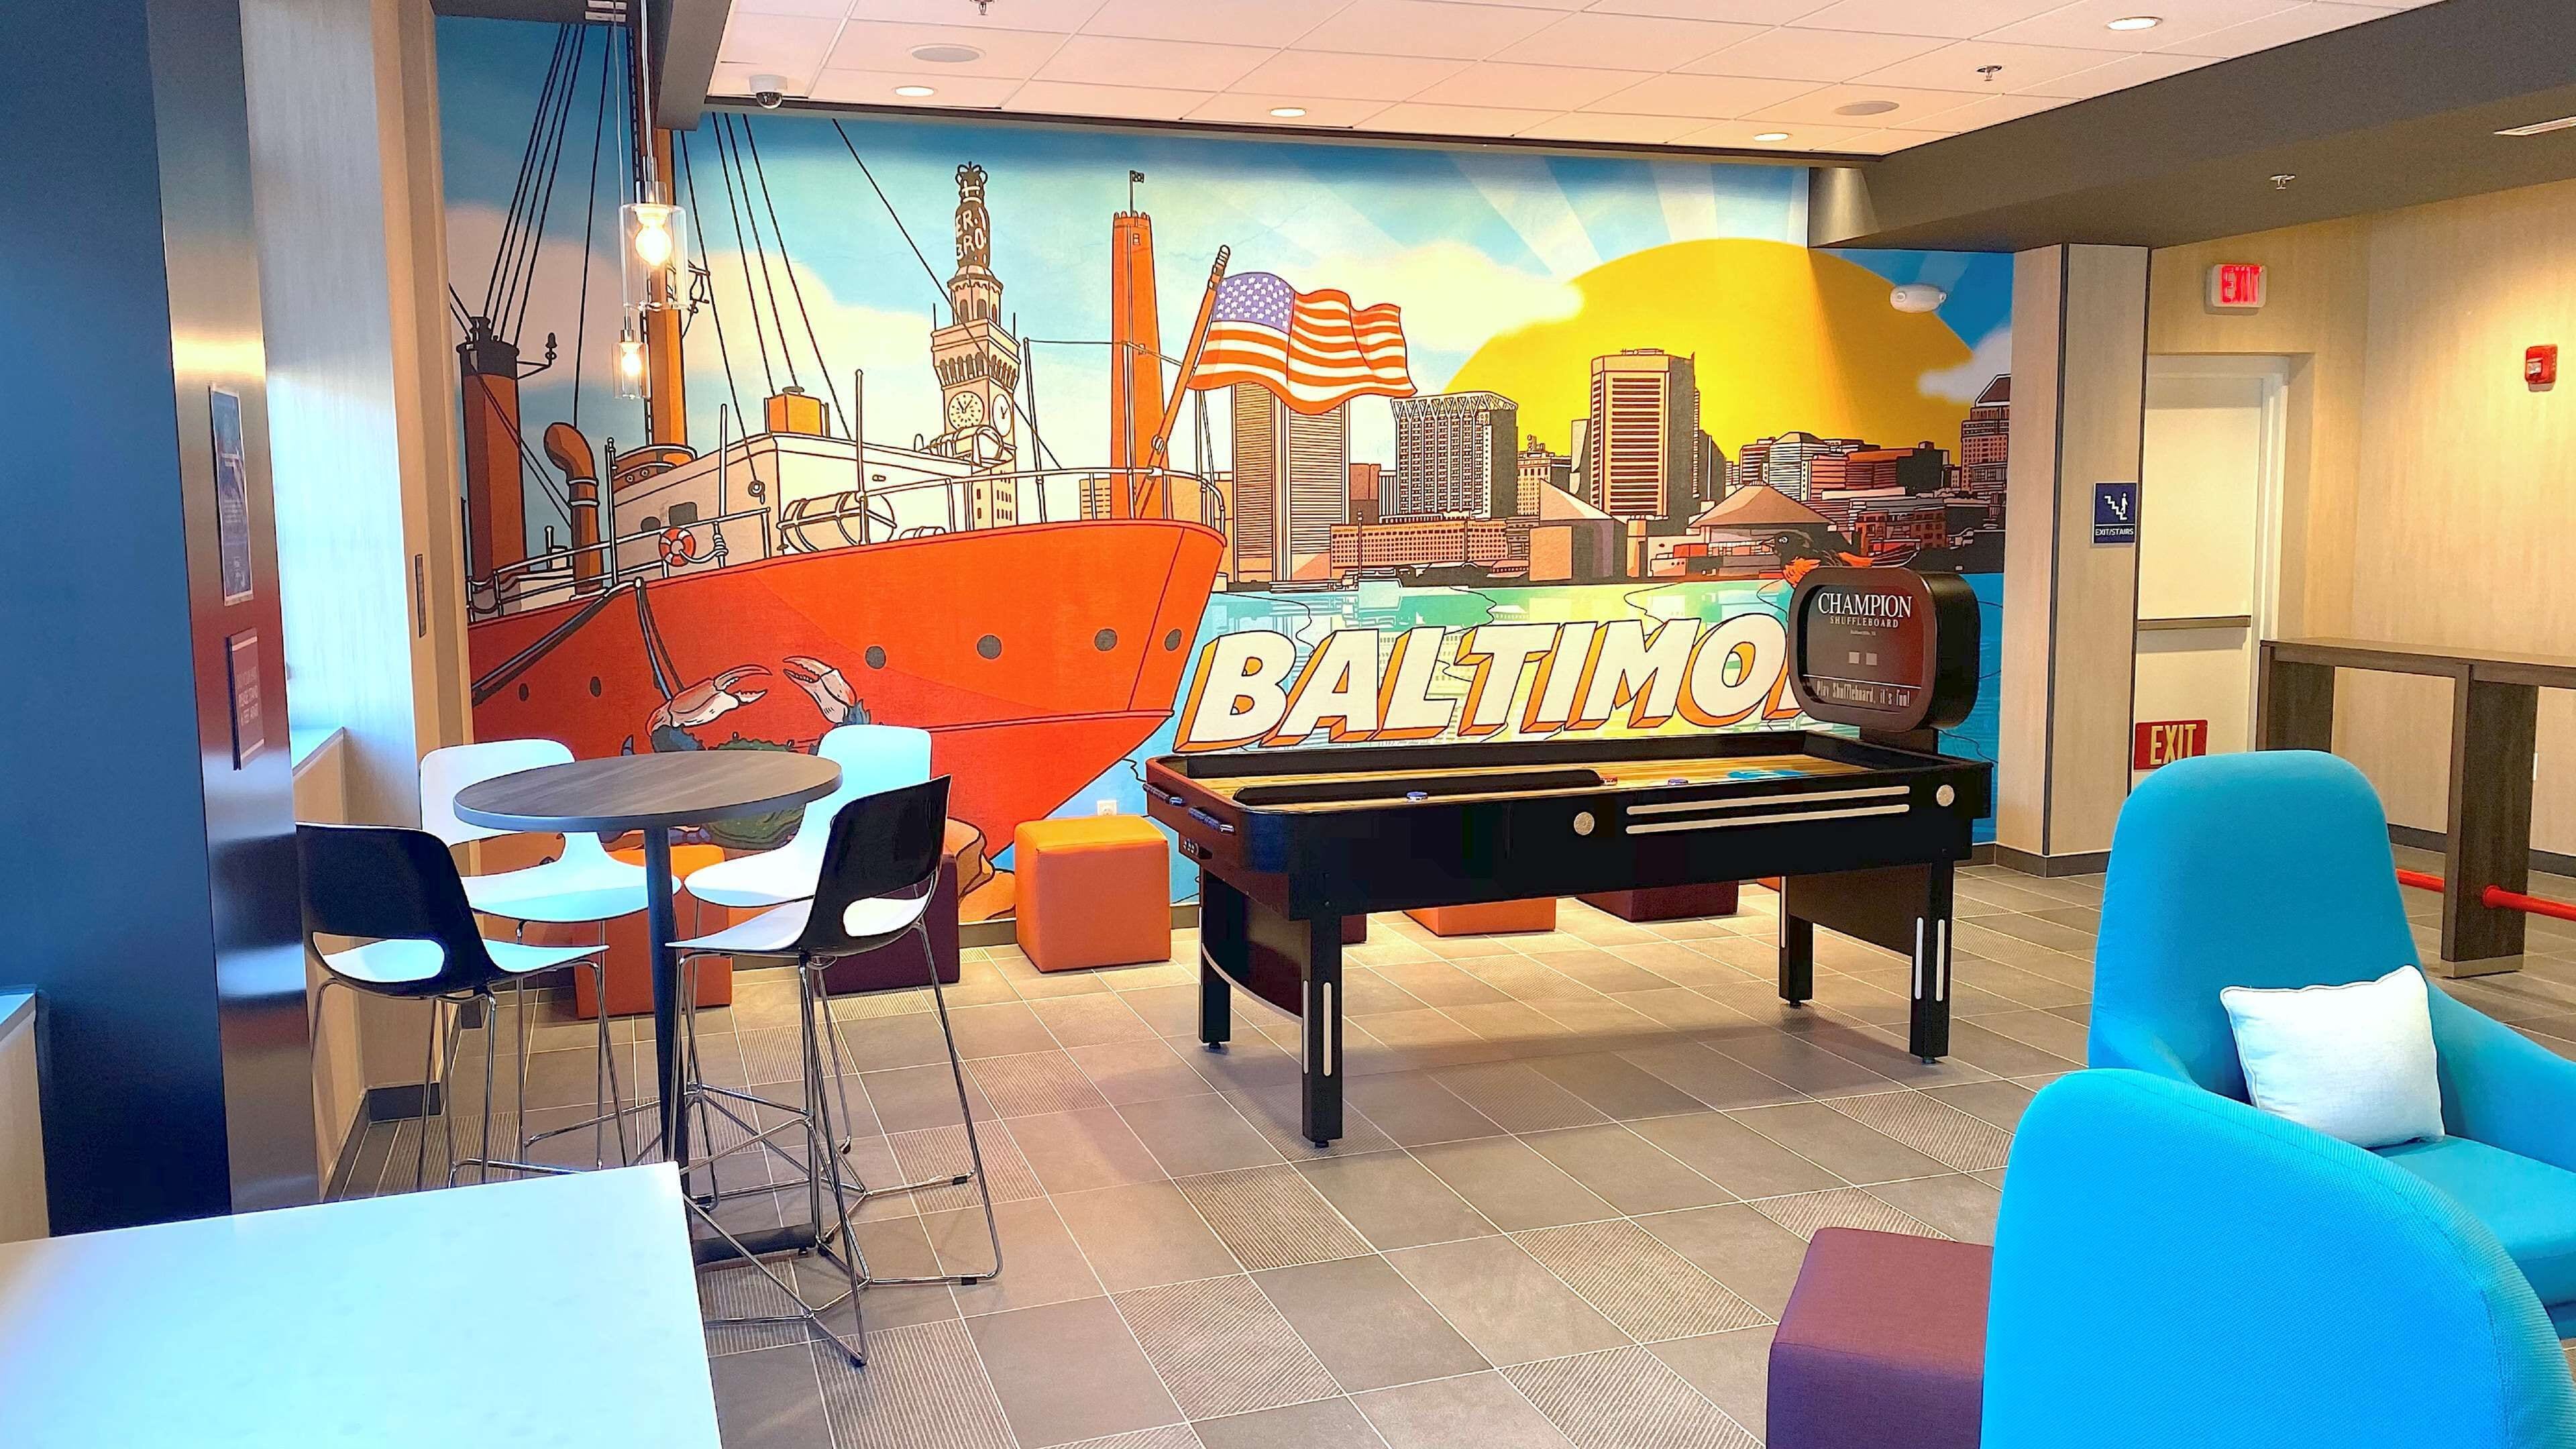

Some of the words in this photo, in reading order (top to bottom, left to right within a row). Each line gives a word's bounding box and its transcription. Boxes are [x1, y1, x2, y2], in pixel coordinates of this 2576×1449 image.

[2221, 265, 2261, 304] EXIT
[2095, 528, 2134, 536] EXIT/STAIRS
[1818, 592, 1913, 618] CHAMPION
[1830, 615, 1899, 629] SHUFFLEBOARD
[1173, 613, 1805, 753] BALTIMO
[1817, 680, 1829, 699] Play
[2150, 724, 2197, 765] EXIT
